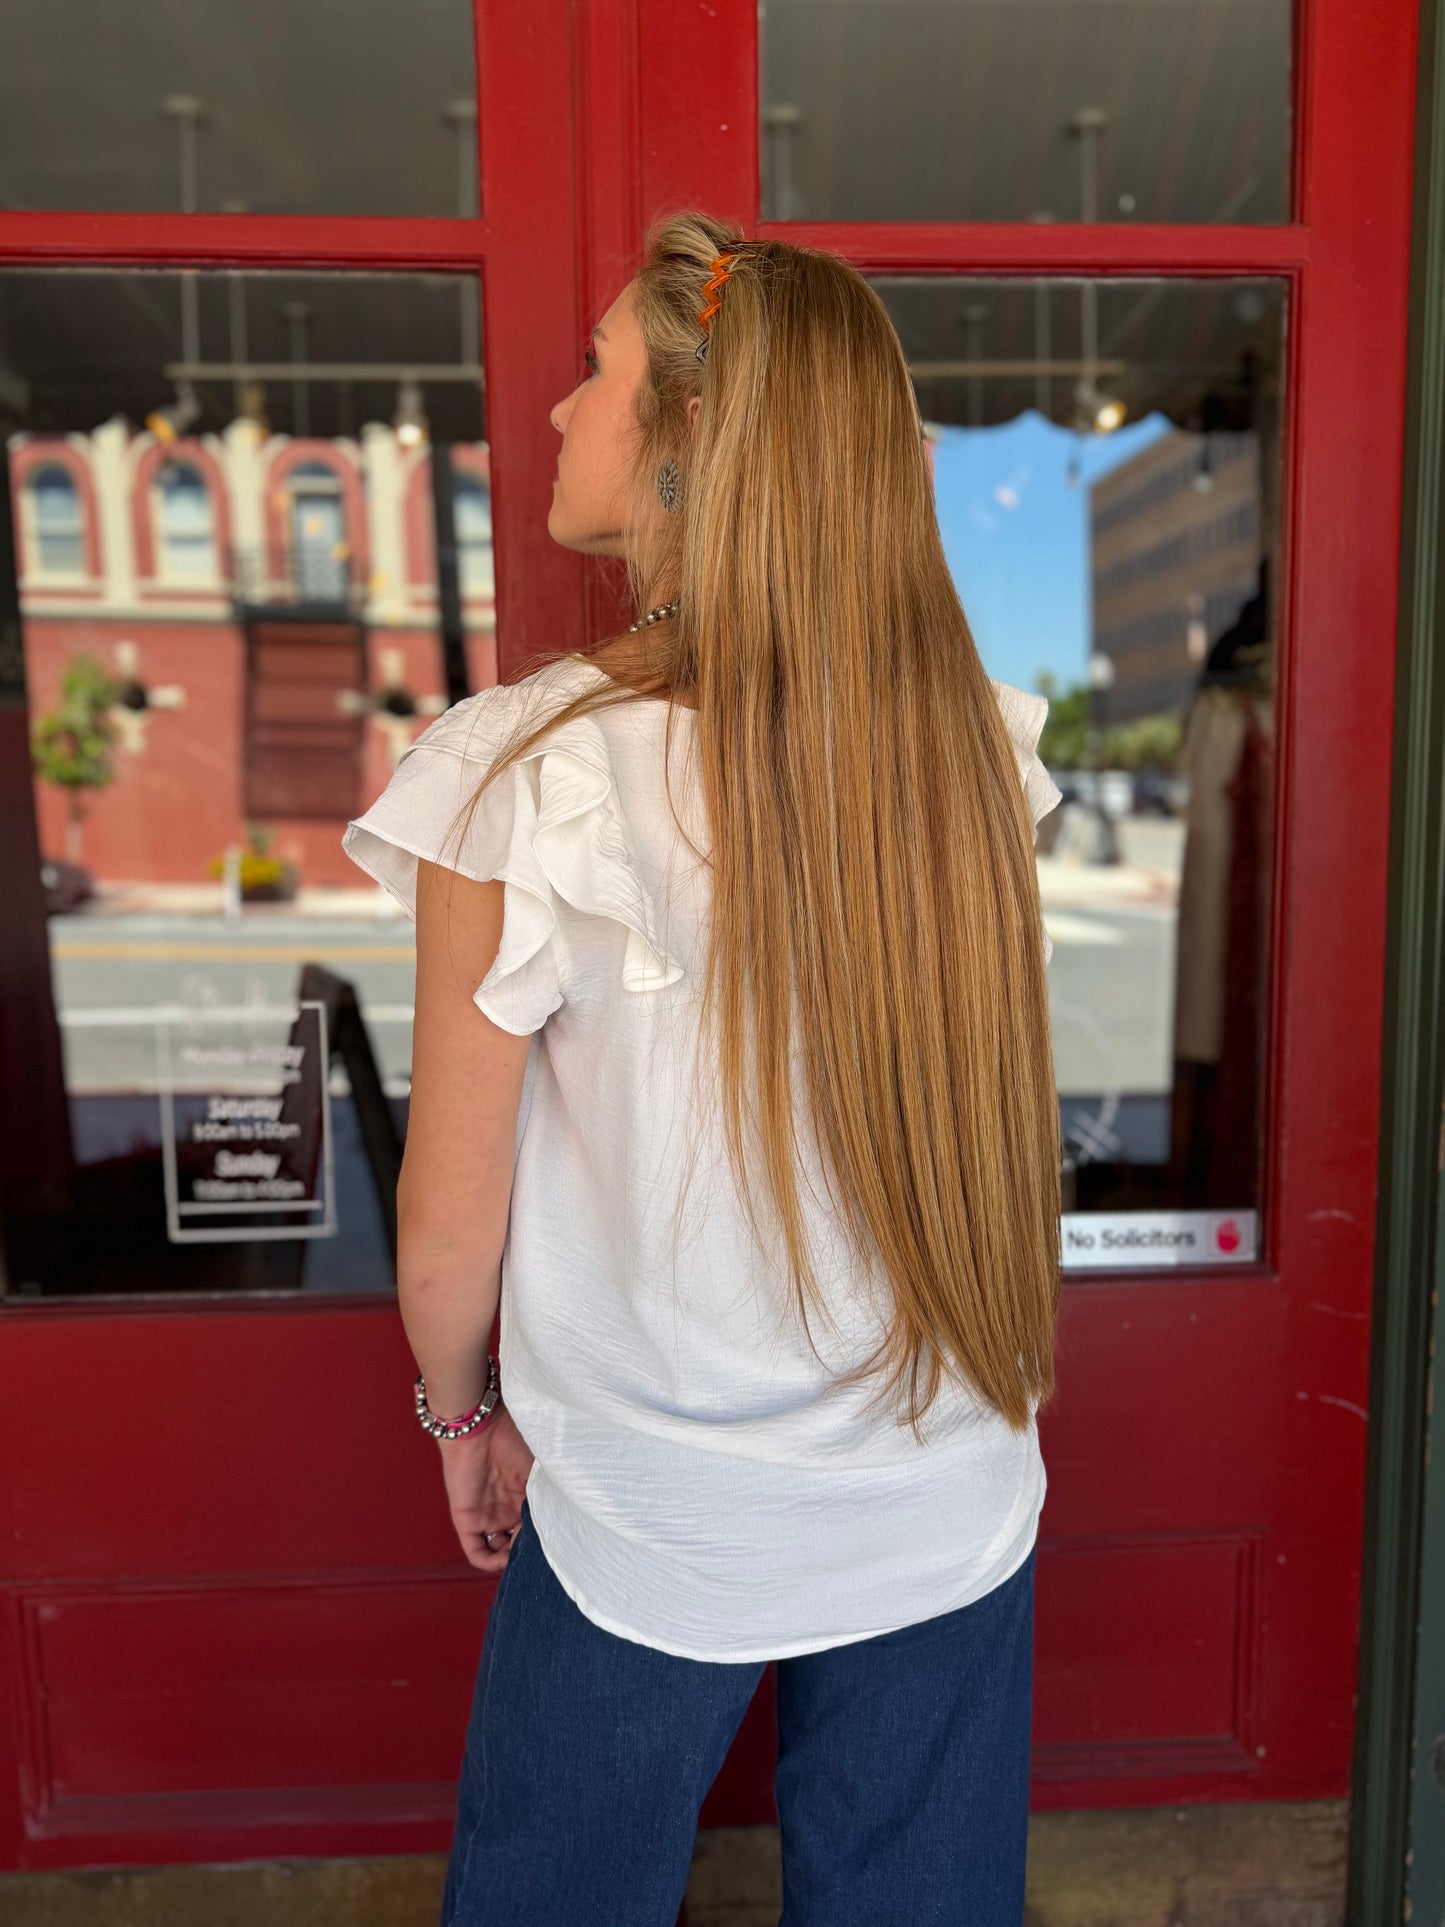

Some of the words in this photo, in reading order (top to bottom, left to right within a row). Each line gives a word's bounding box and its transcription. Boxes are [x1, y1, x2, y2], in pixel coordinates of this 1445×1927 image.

[208, 1097, 283, 1121] Saturday
[214, 1149, 281, 1178] Sunday
[1066, 1229, 1095, 1249] No
[1100, 1226, 1198, 1248] Solicitors
